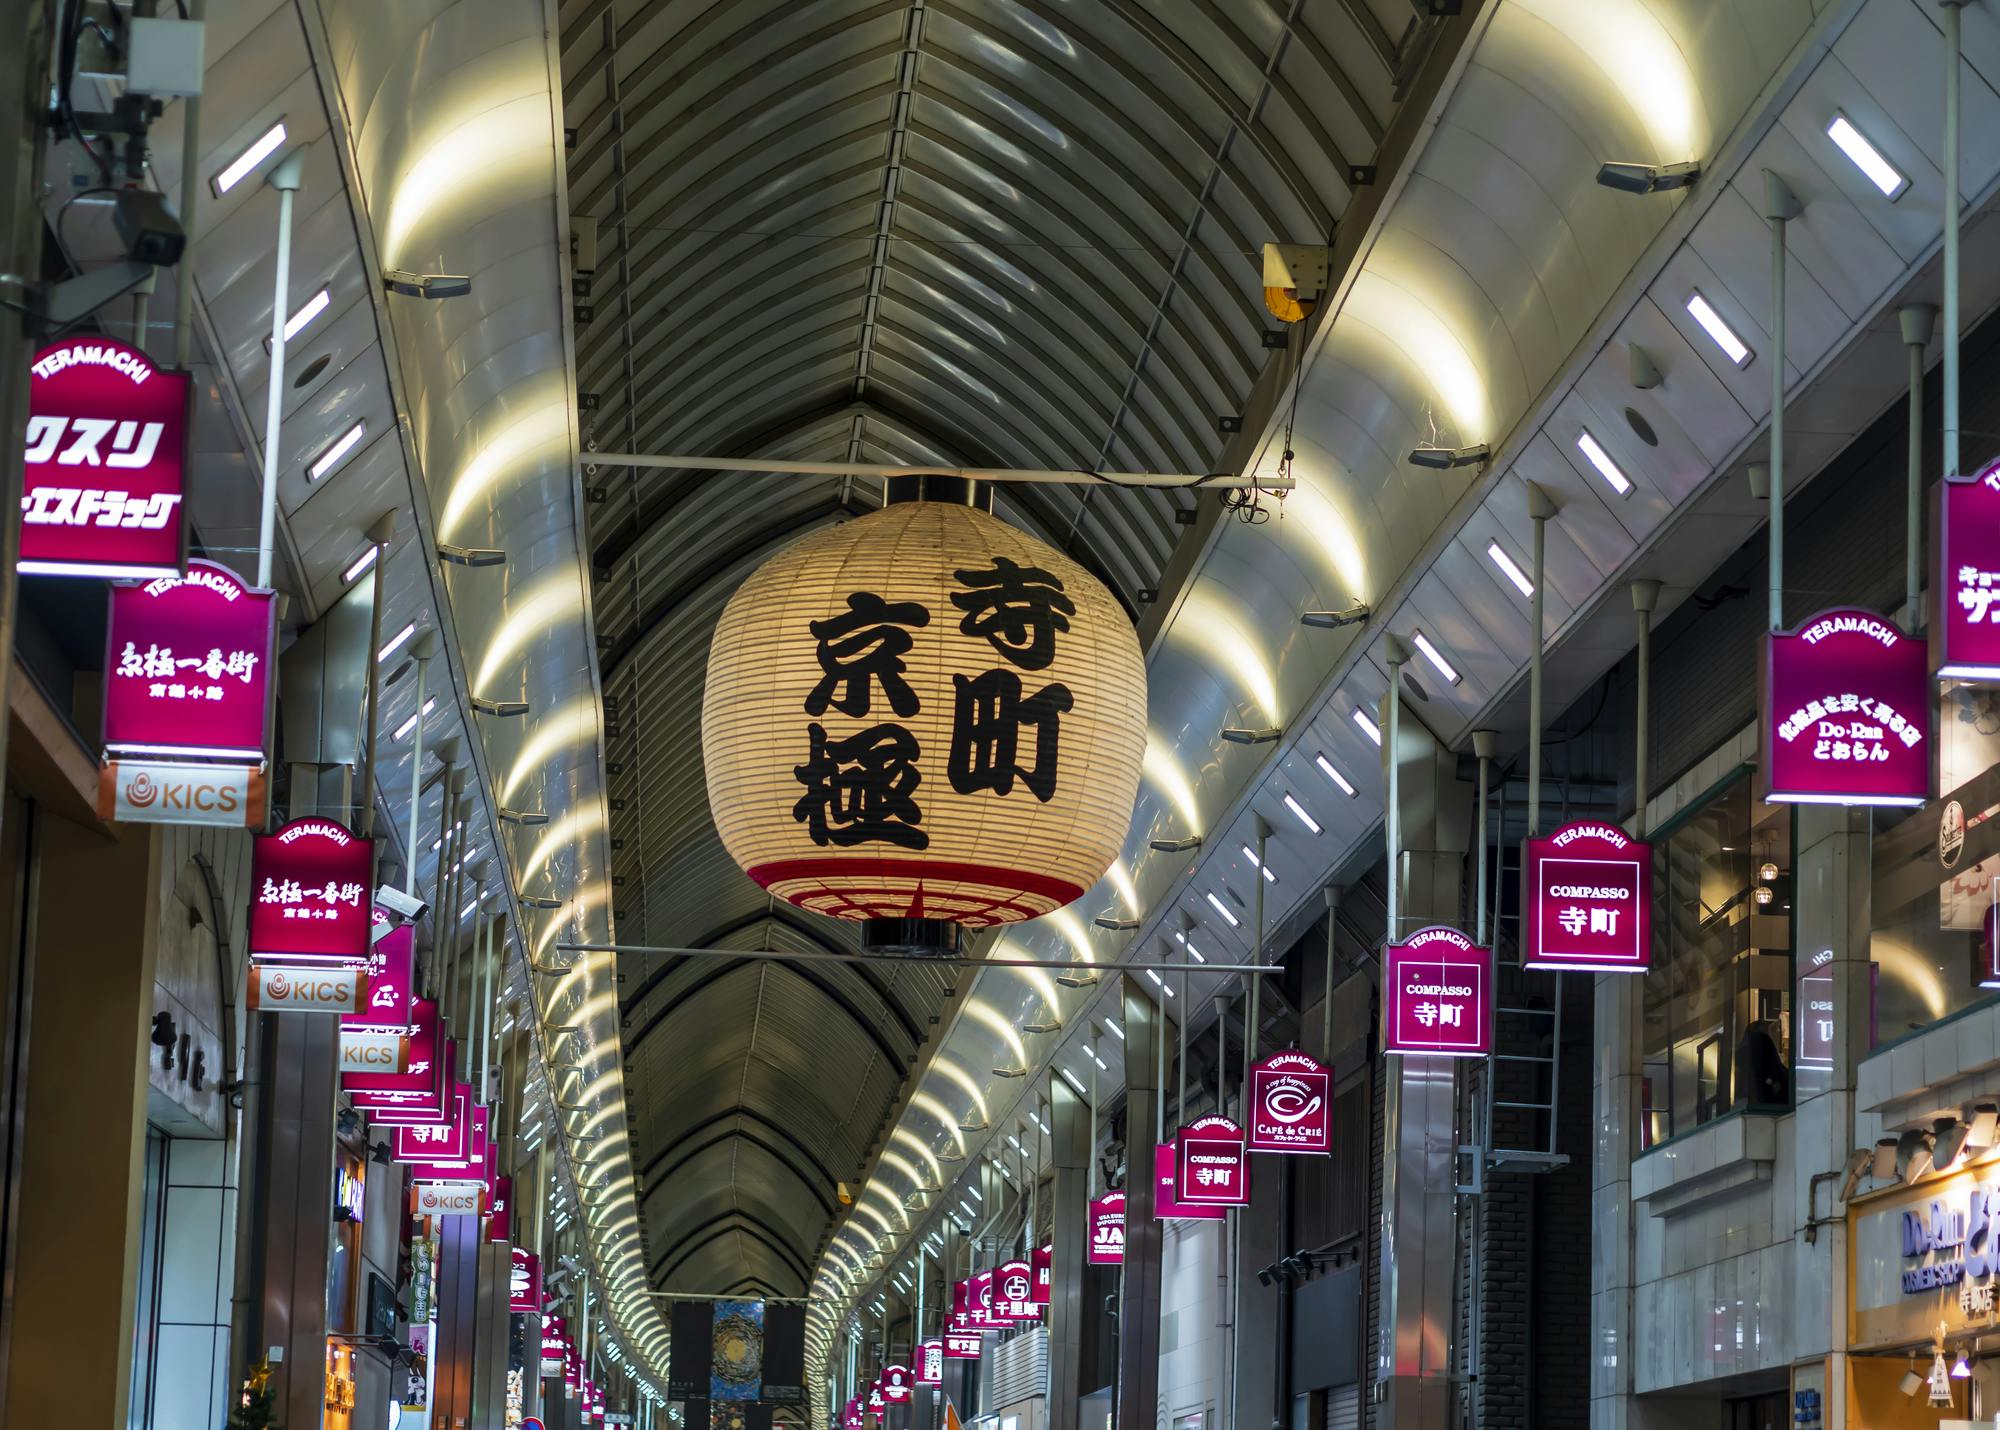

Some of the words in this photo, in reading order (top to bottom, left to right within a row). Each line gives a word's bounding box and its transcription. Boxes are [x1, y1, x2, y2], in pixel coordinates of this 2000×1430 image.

[31, 346, 151, 384] TERAMACHI
[24, 415, 165, 469] クスリ
[1802, 616, 1898, 648] TERAMACHI
[116, 642, 259, 683] 京極一番街
[947, 557, 1076, 803] 寺町
[793, 591, 930, 851] 京極
[1778, 693, 1923, 749] 化粧品を安く売る店
[1813, 740, 1890, 762] どおらん
[161, 784, 238, 812] KICS
[278, 824, 350, 847] TERAMACHI
[1552, 826, 1628, 850] TERAMACHI
[259, 877, 364, 907] 京極一番街
[1550, 885, 1630, 900] COMPASSO
[1558, 906, 1621, 936] 寺町
[1408, 931, 1471, 951] TERAMACHI
[293, 981, 349, 1002] KICS
[1406, 984, 1472, 997] COMPASSO
[1414, 1002, 1464, 1027] 寺町
[344, 1046, 393, 1064] KICS
[1267, 1055, 1318, 1072] TERAMACHI
[1280, 1076, 1287, 1085] of
[1286, 1076, 1311, 1092] happiness
[412, 1126, 449, 1143] 寺町
[1192, 1117, 1237, 1132] TERAMACHI
[1285, 1125, 1296, 1135] de
[1190, 1155, 1238, 1164] COMPASSO
[1196, 1168, 1232, 1186] 寺町
[440, 1197, 474, 1209] KICS
[994, 1301, 1040, 1316] 千里眼
